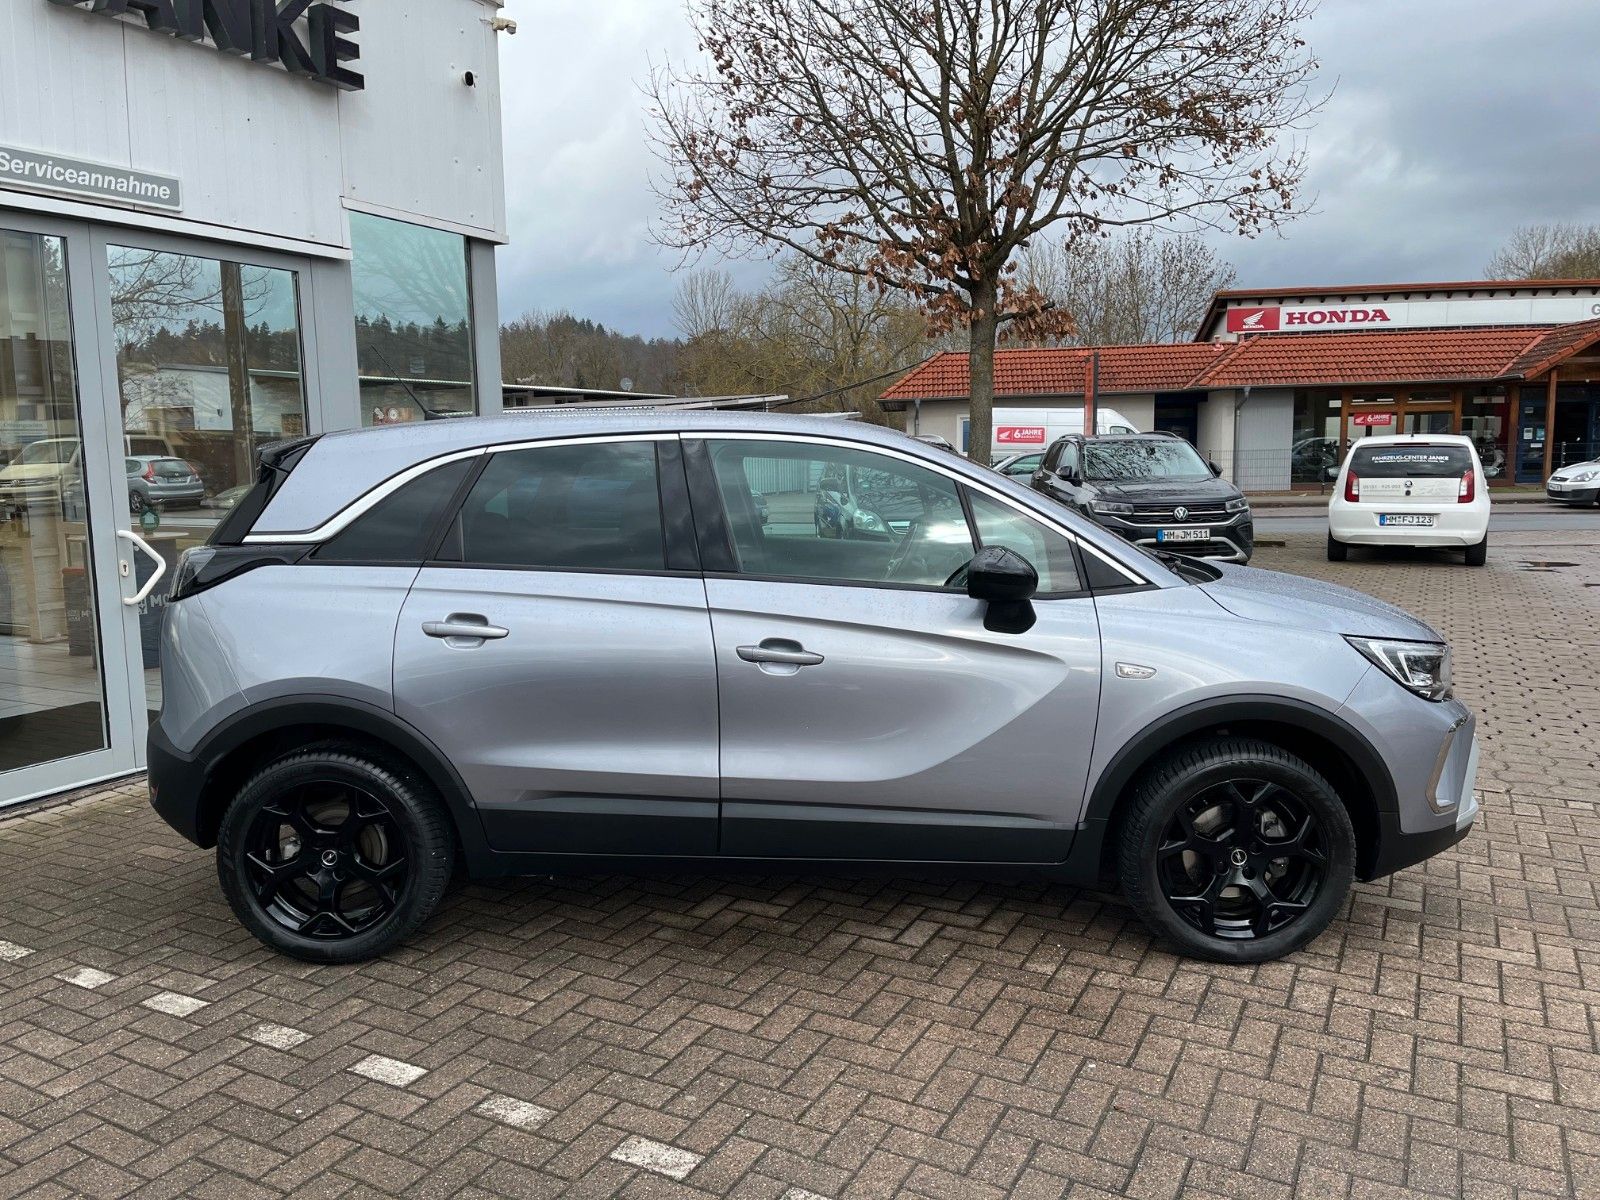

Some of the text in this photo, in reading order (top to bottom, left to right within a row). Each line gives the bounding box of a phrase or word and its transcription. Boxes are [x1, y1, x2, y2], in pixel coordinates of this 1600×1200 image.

[0, 152, 171, 200] Serviceannahme
[1285, 309, 1391, 325] HONDA
[1367, 414, 1373, 423] 6
[1013, 429, 1021, 439] 6
